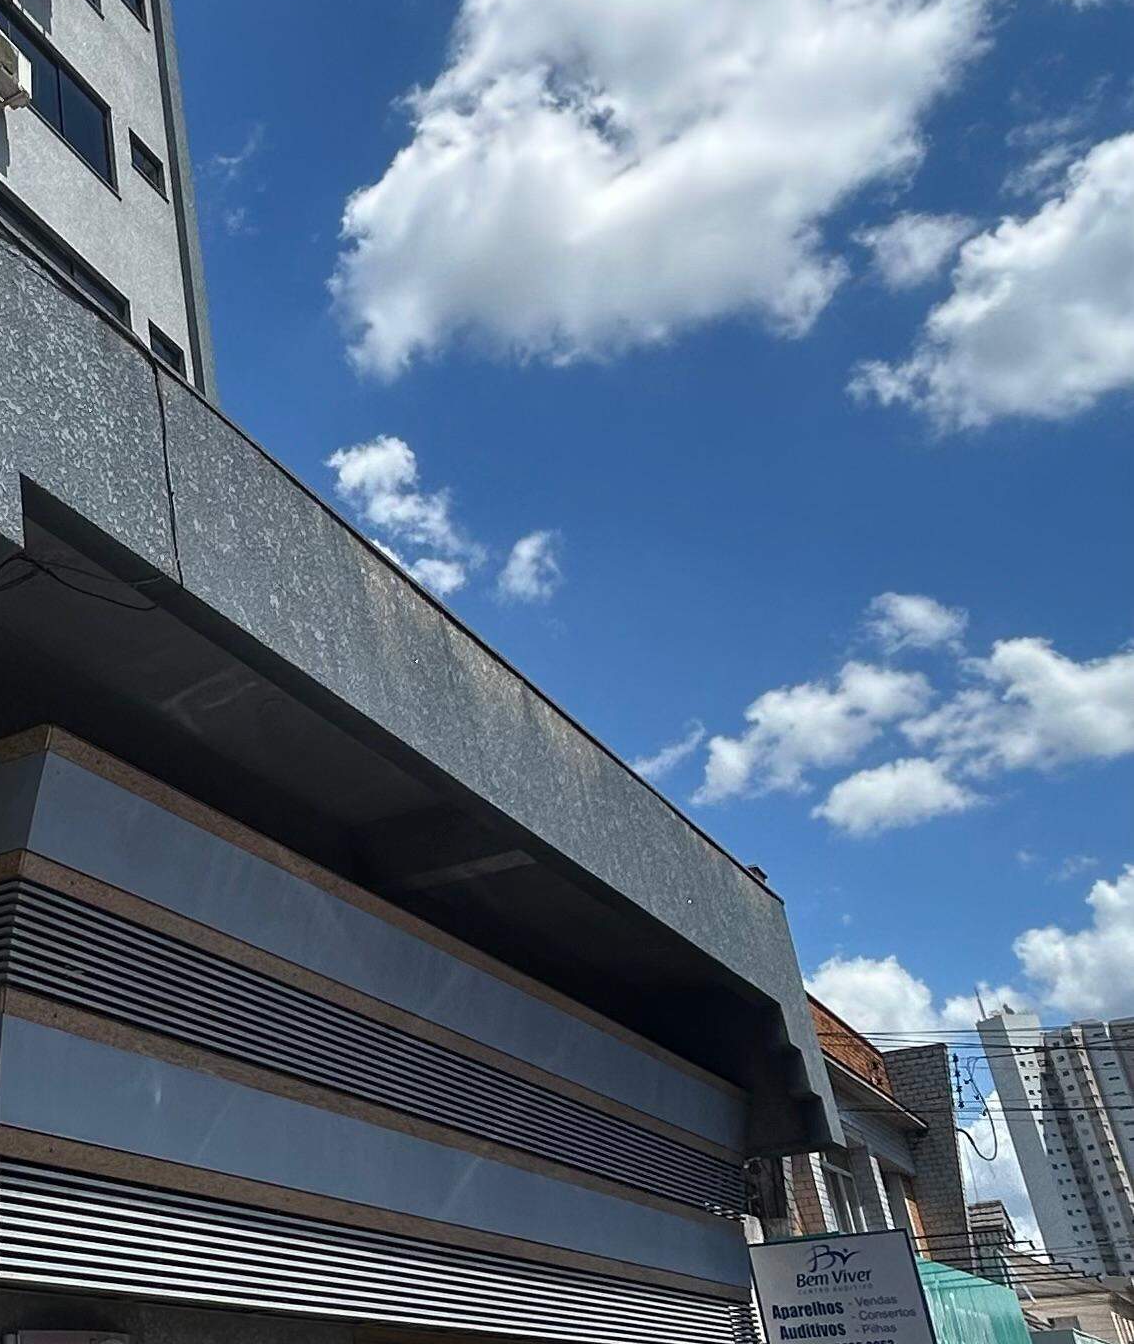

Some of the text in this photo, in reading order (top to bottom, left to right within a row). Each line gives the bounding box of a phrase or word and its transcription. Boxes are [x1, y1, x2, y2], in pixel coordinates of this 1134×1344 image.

[796, 1269, 873, 1288] Bem Viver
[854, 1296, 898, 1307] Vendas
[772, 1301, 844, 1320] Aparelhos
[859, 1308, 916, 1320] Consertos
[780, 1323, 846, 1340] Auditivos
